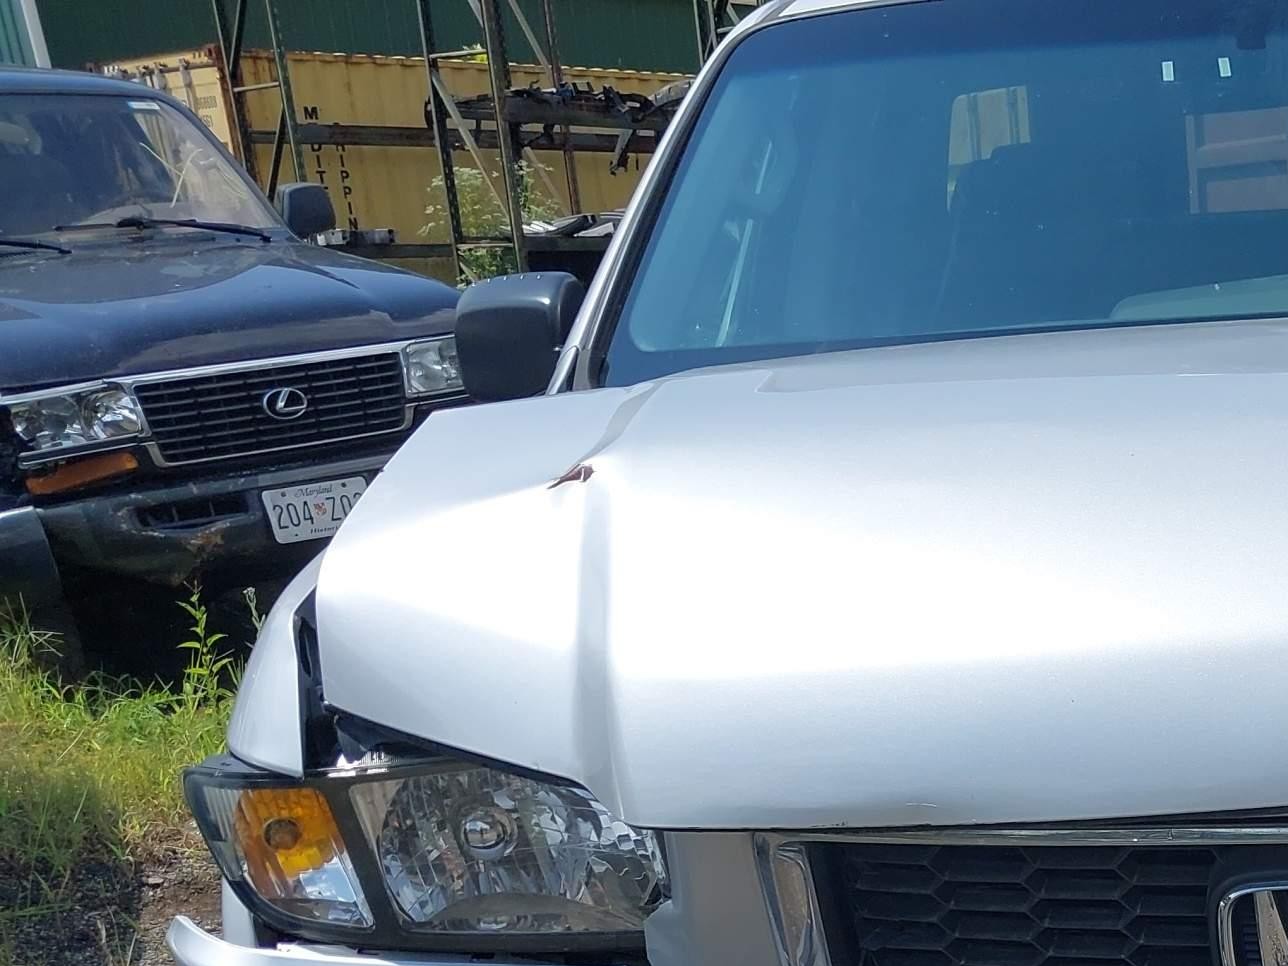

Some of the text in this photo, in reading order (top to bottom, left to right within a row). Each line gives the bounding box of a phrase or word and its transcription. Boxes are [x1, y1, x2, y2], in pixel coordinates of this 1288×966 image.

[294, 484, 333, 500] Maryland
[273, 492, 363, 530] 204 Z0
